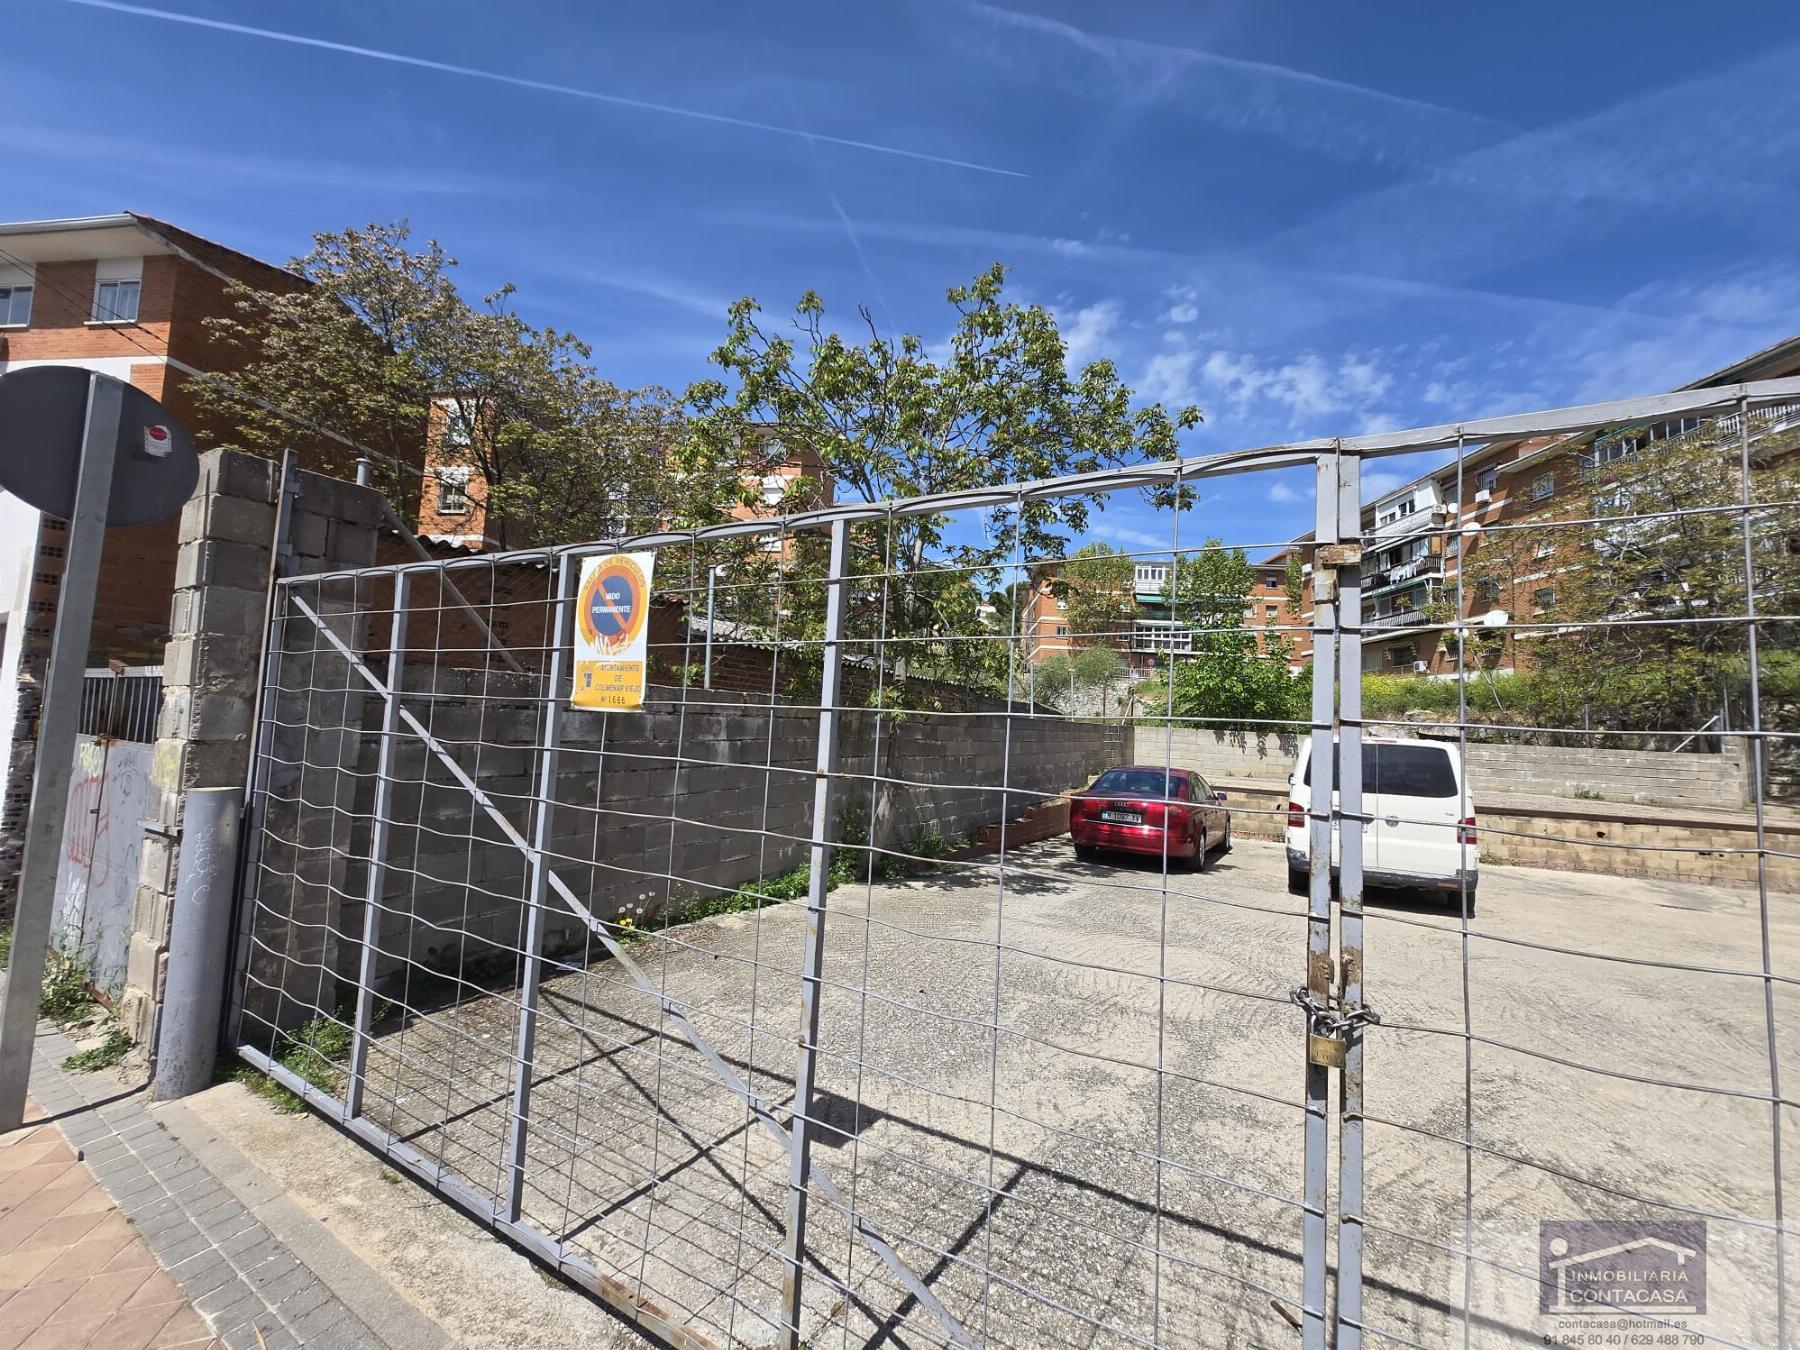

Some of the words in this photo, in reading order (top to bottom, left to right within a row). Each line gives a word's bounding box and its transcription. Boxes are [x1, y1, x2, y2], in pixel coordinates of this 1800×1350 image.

[605, 592, 621, 600] VADO
[592, 605, 631, 614] PERMANENTE
[600, 664, 640, 672] AYUNTAMIENTO
[614, 674, 623, 683] DE
[595, 683, 624, 692] COLMENAR
